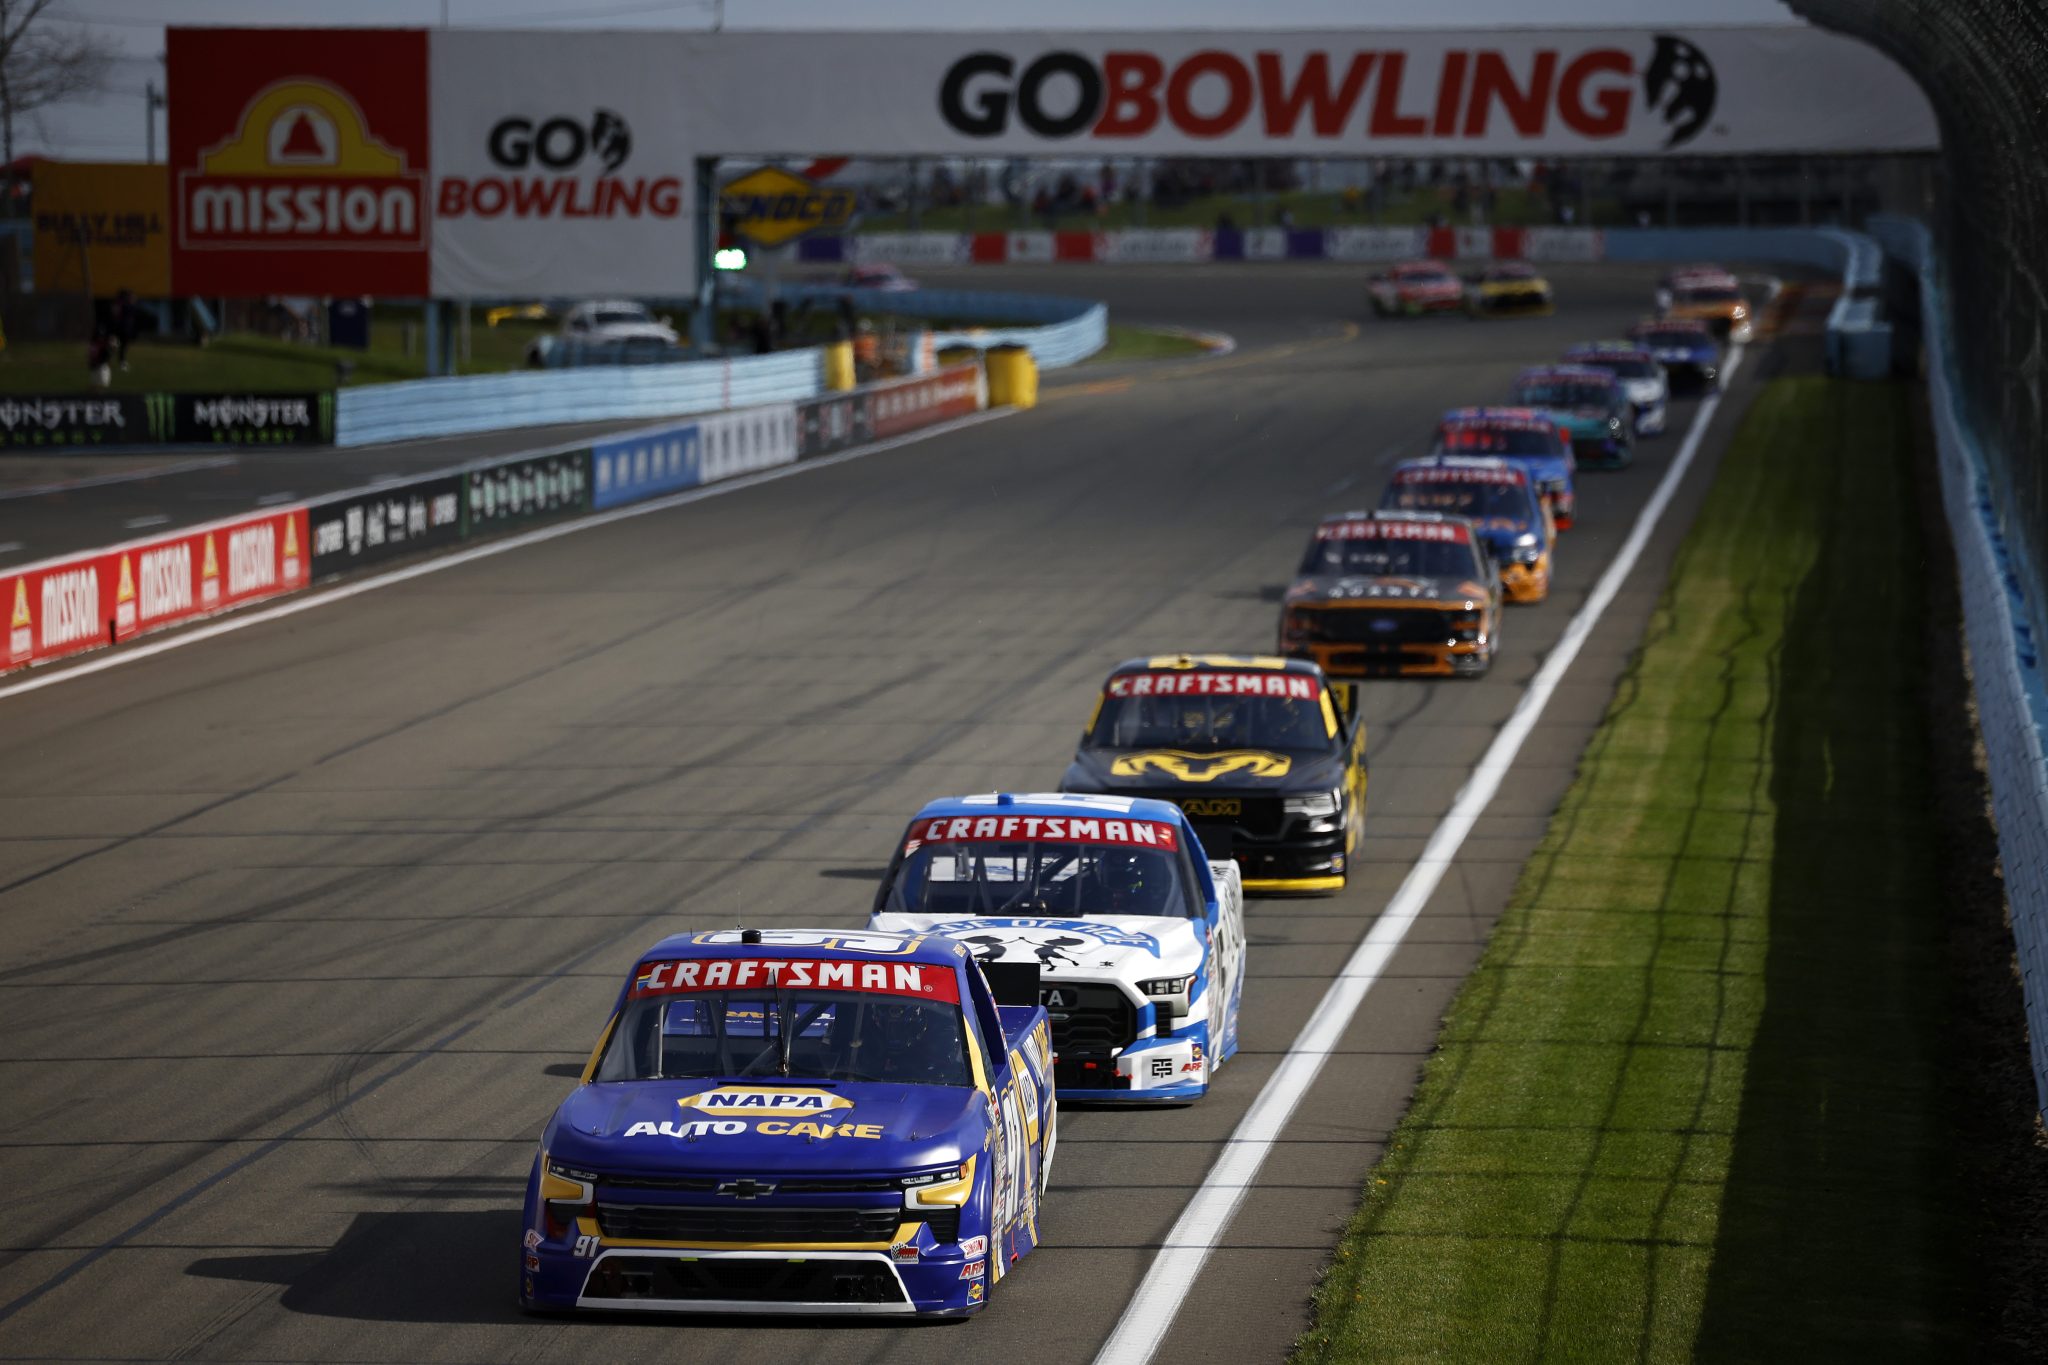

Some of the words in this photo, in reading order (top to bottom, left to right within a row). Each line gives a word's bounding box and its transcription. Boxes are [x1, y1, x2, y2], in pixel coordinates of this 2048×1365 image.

[488, 116, 586, 171] GO
[192, 185, 413, 234] MISSION
[436, 176, 683, 219] BOWLING
[0, 397, 125, 431] ONSTER
[193, 396, 310, 429] MONSTER
[139, 542, 192, 621] MISSION
[41, 565, 99, 649] MISSION
[1116, 674, 1310, 698] CRAFTSMAN
[1182, 798, 1242, 816] AM
[925, 818, 1157, 845] CRAFTSMAN
[647, 961, 921, 991] CRAFTSMAN
[707, 1094, 824, 1108] NAPA
[624, 1121, 747, 1138] AUTO
[756, 1121, 884, 1140] CARE
[573, 1235, 600, 1258] 91
[961, 1261, 984, 1277] ARP
